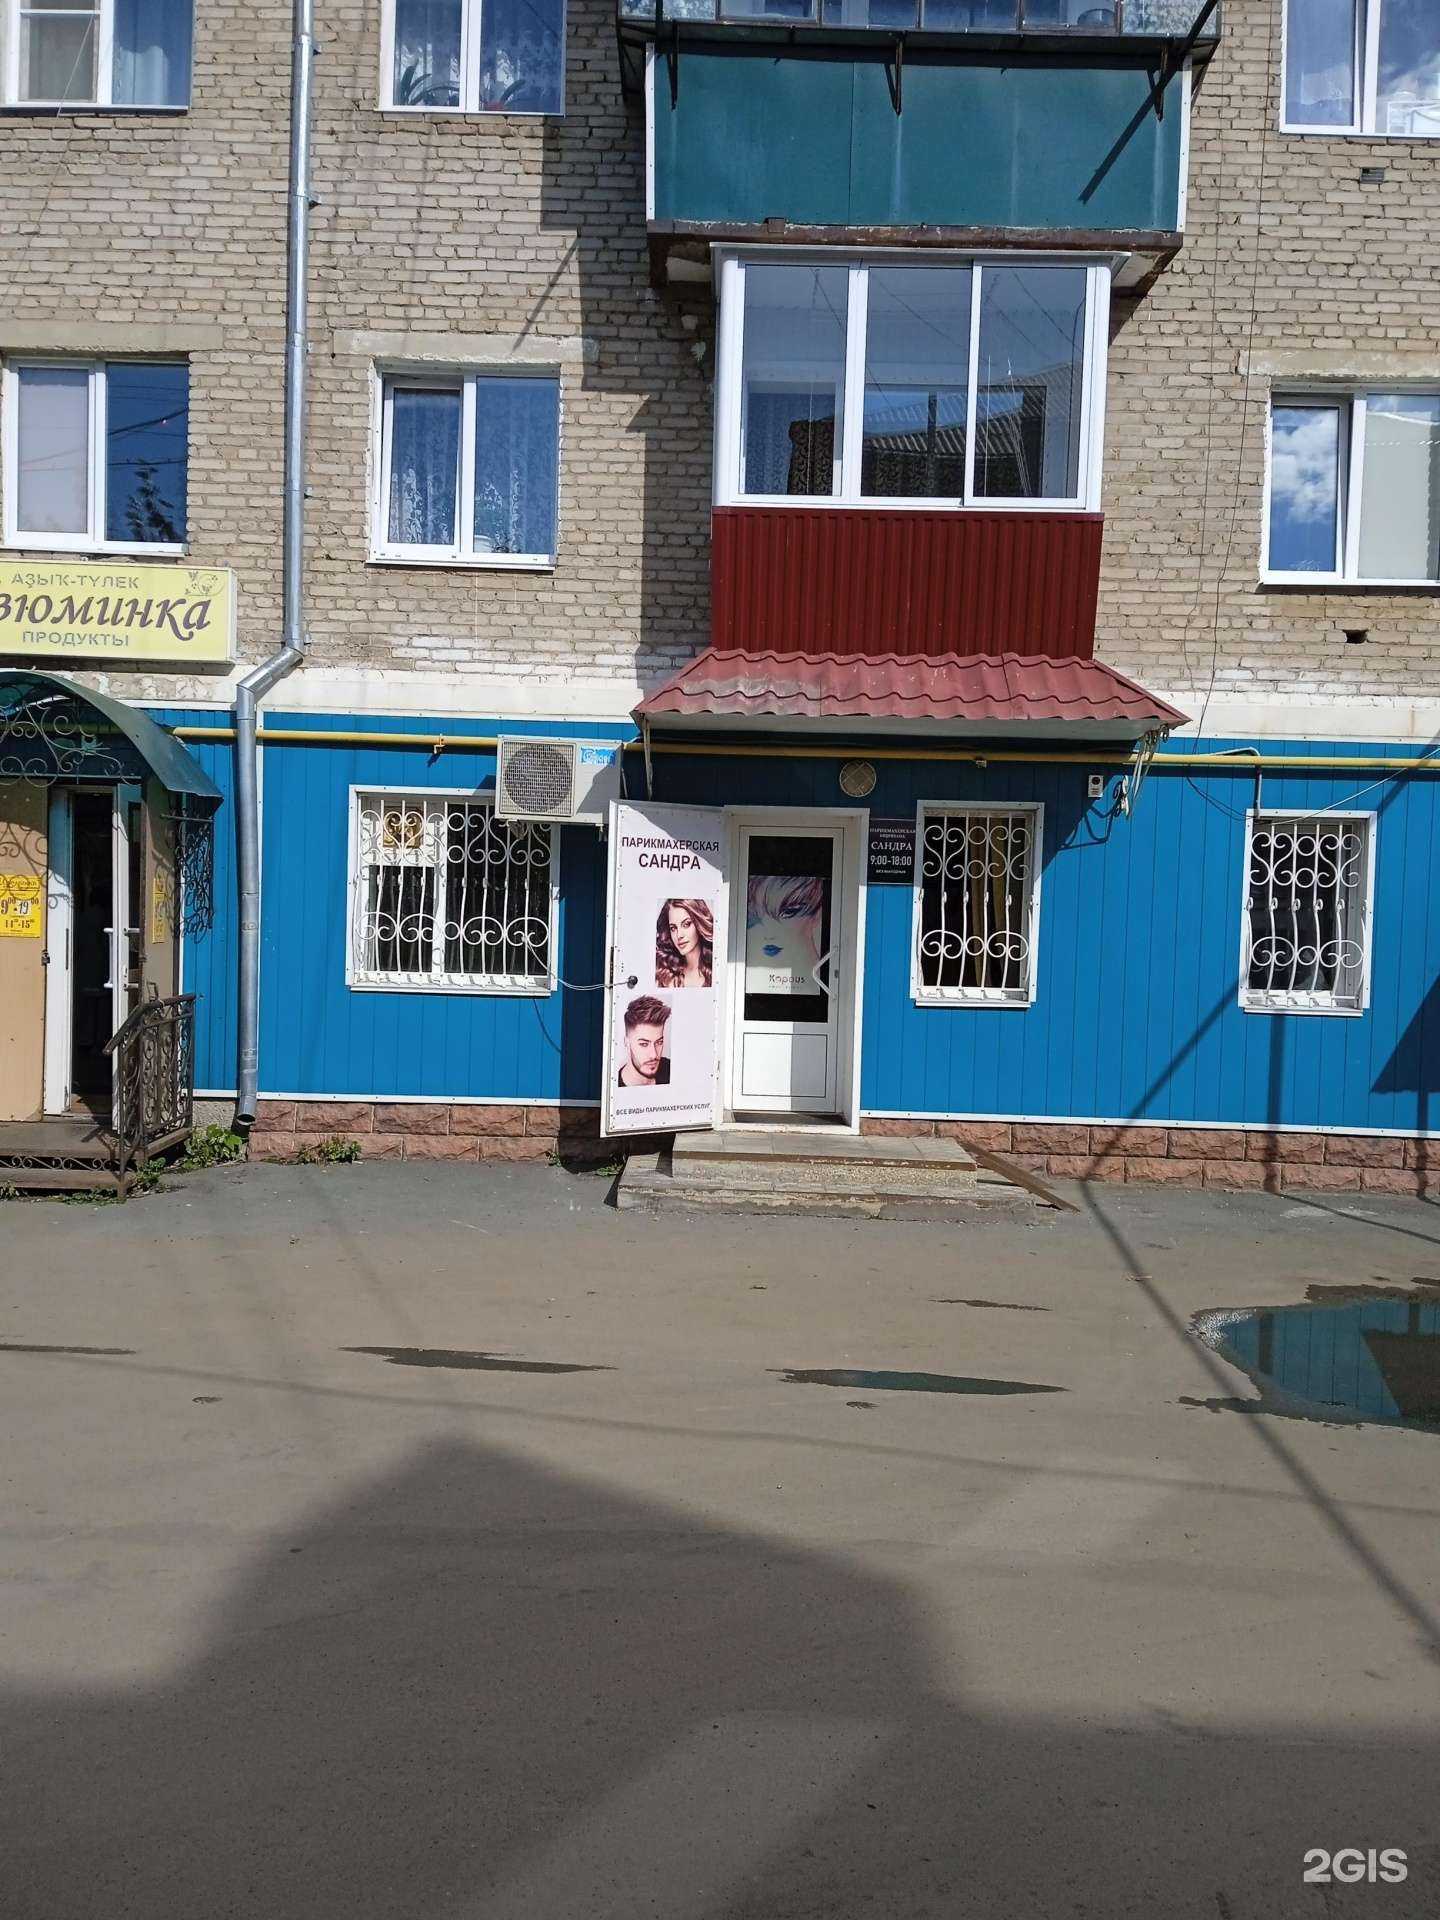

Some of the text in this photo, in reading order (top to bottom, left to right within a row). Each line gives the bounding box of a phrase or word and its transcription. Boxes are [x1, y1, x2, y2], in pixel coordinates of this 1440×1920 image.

[22, 631, 129, 646] ПРОДУКТЫ
[621, 836, 720, 852] ПАРИКМАХЕРСКАЯ
[871, 841, 912, 851] САНДРА
[638, 853, 701, 872] САНДРА
[645, 1104, 693, 1113] ПАРИКМАХЕРСКИХ
